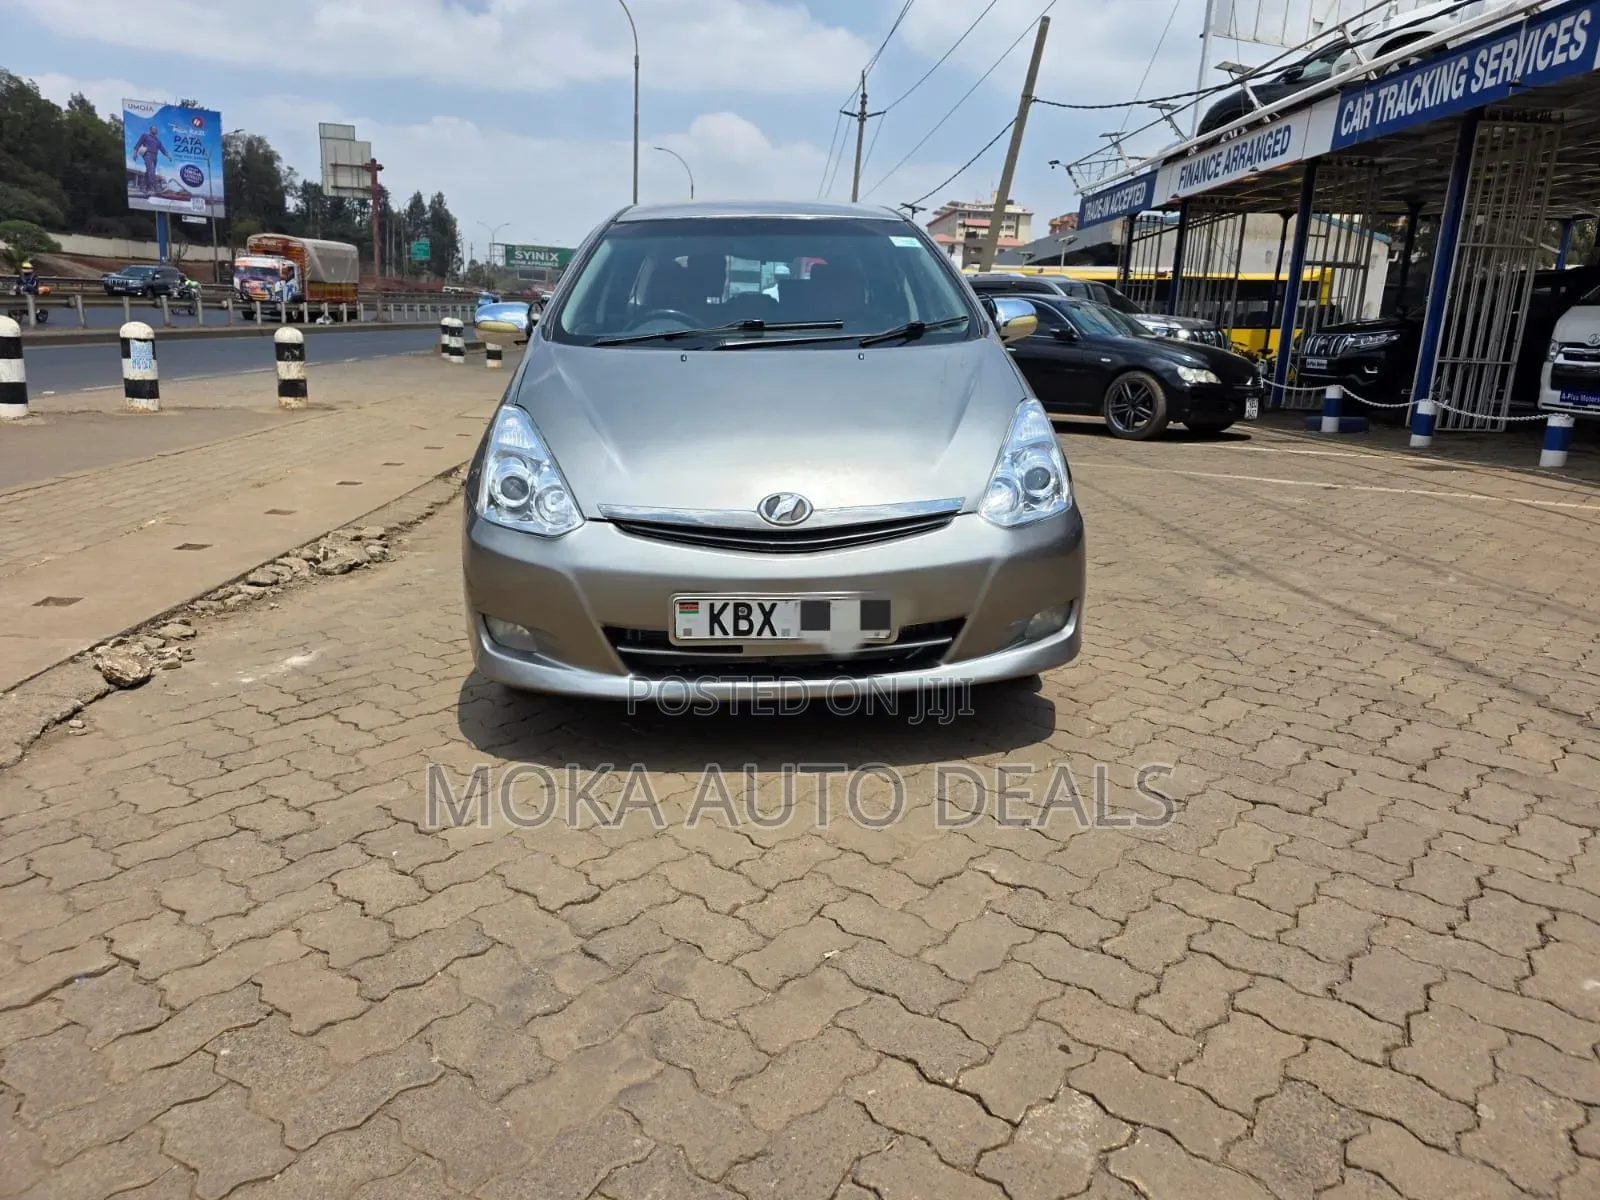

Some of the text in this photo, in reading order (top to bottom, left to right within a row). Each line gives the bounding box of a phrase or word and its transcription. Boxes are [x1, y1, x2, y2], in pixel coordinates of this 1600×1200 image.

[1341, 9, 1592, 137] CAR TRACKING SERVICES
[174, 135, 202, 146] PATA
[1178, 124, 1292, 191] FINANCE ARRANGED
[1084, 181, 1147, 224] TRADE-IN ACCEPTED
[708, 601, 778, 637] KBX
